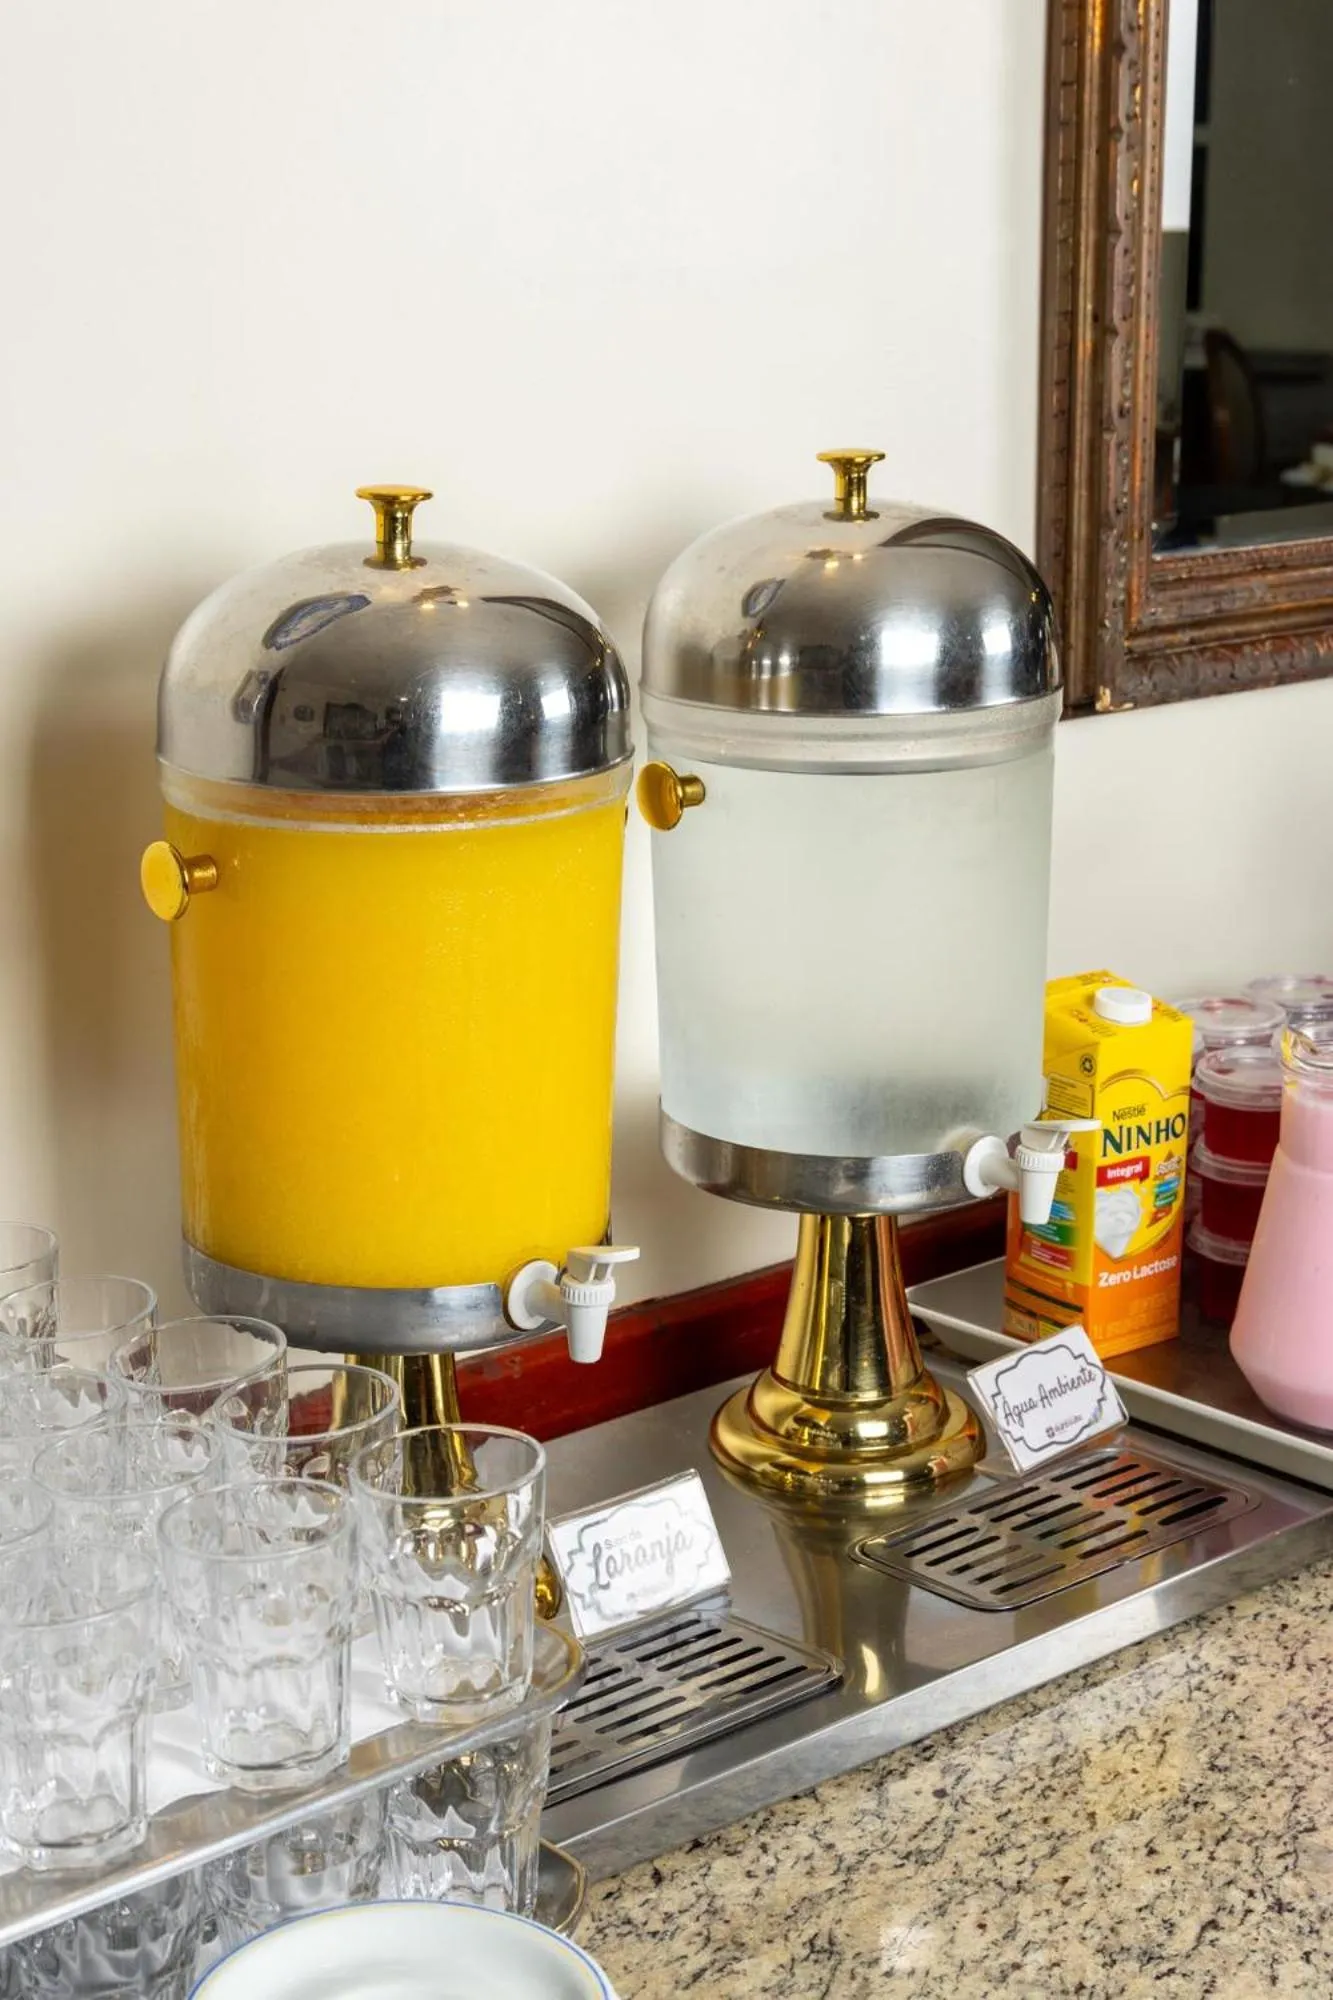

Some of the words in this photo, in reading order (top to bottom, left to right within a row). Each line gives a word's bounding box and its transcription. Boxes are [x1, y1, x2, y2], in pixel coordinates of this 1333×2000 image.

[1102, 1112, 1186, 1157] NINHO
[1106, 1161, 1143, 1179] Integral
[1098, 1270, 1132, 1288] Zero
[1132, 1255, 1178, 1280] Lactose
[1038, 1366, 1096, 1408] Ambiente
[586, 1521, 694, 1591] Laranja
